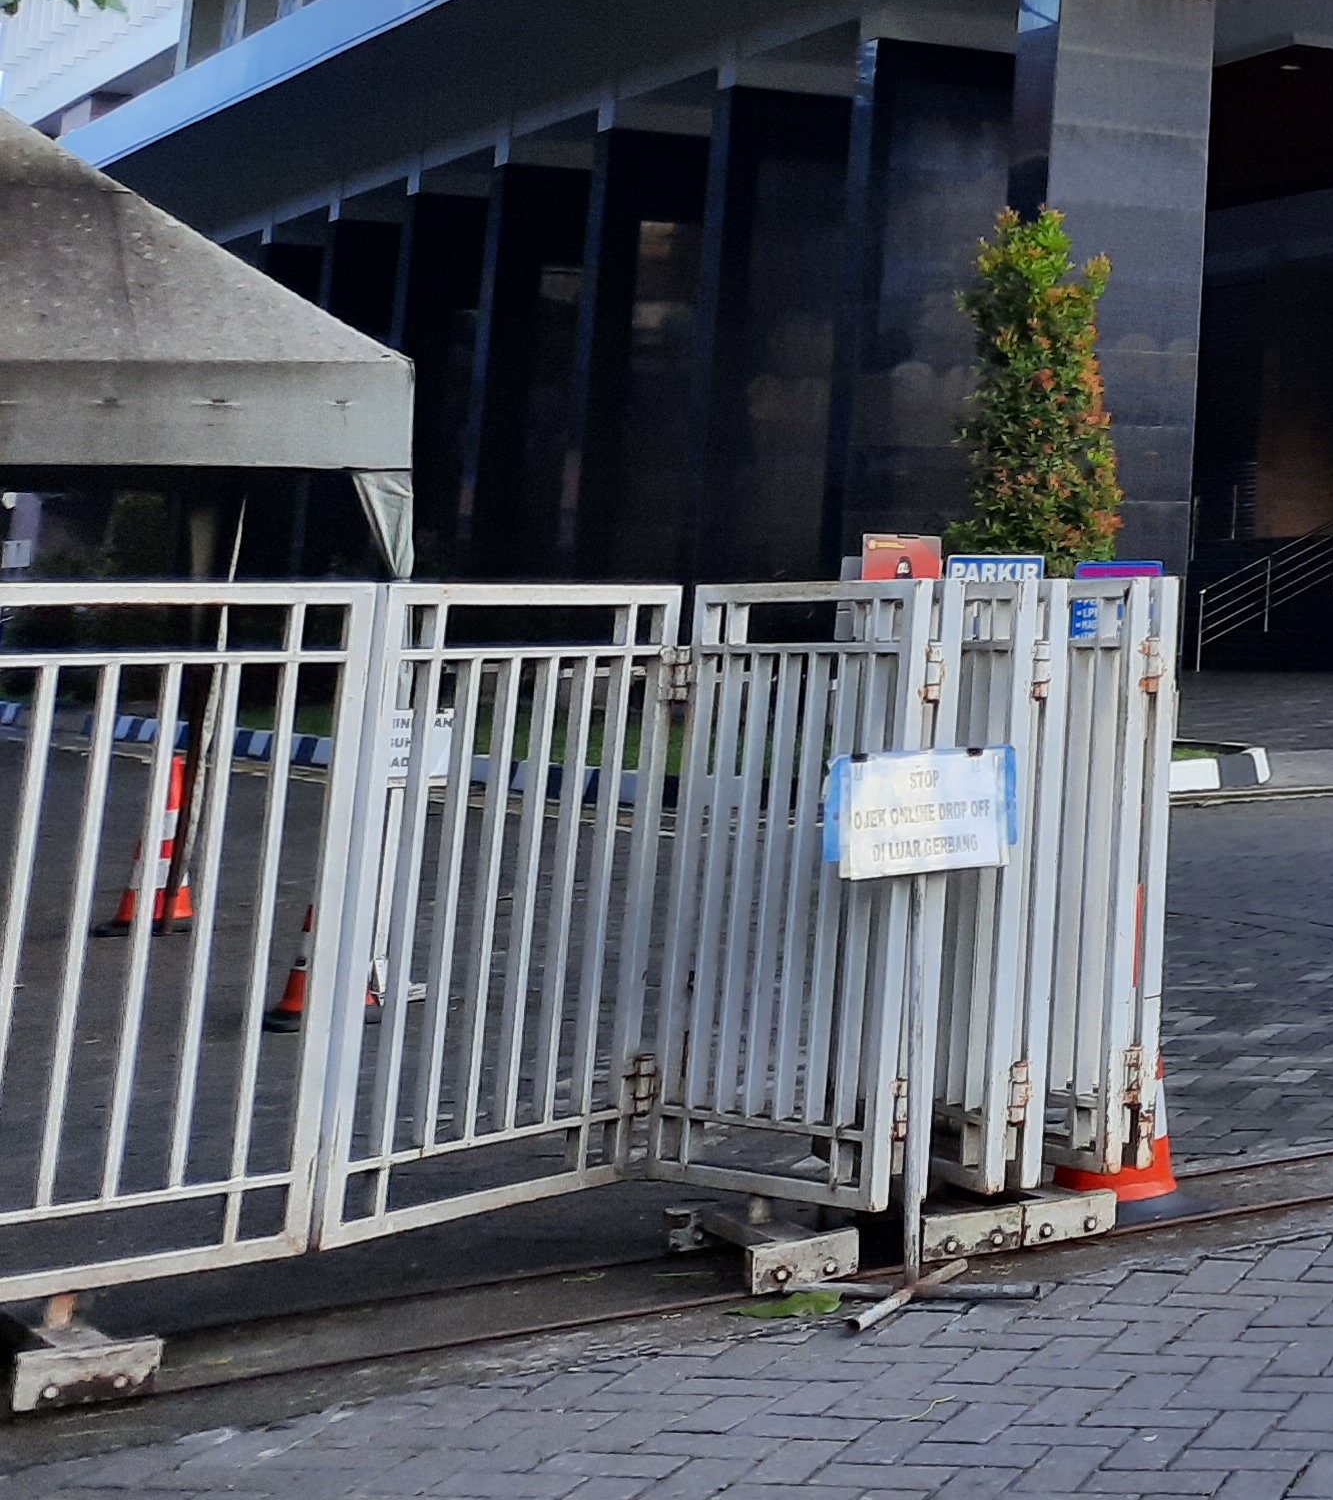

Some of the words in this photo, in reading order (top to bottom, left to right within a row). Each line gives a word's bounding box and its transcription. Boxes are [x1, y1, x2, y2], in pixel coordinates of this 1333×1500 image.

[949, 561, 1040, 582] PARKIR
[908, 769, 940, 790] STOP
[938, 800, 968, 821] DROP
[971, 799, 991, 819] OFF
[872, 842, 885, 863] DI
[888, 839, 921, 861] LUAR
[924, 833, 978, 858] GERBANG
